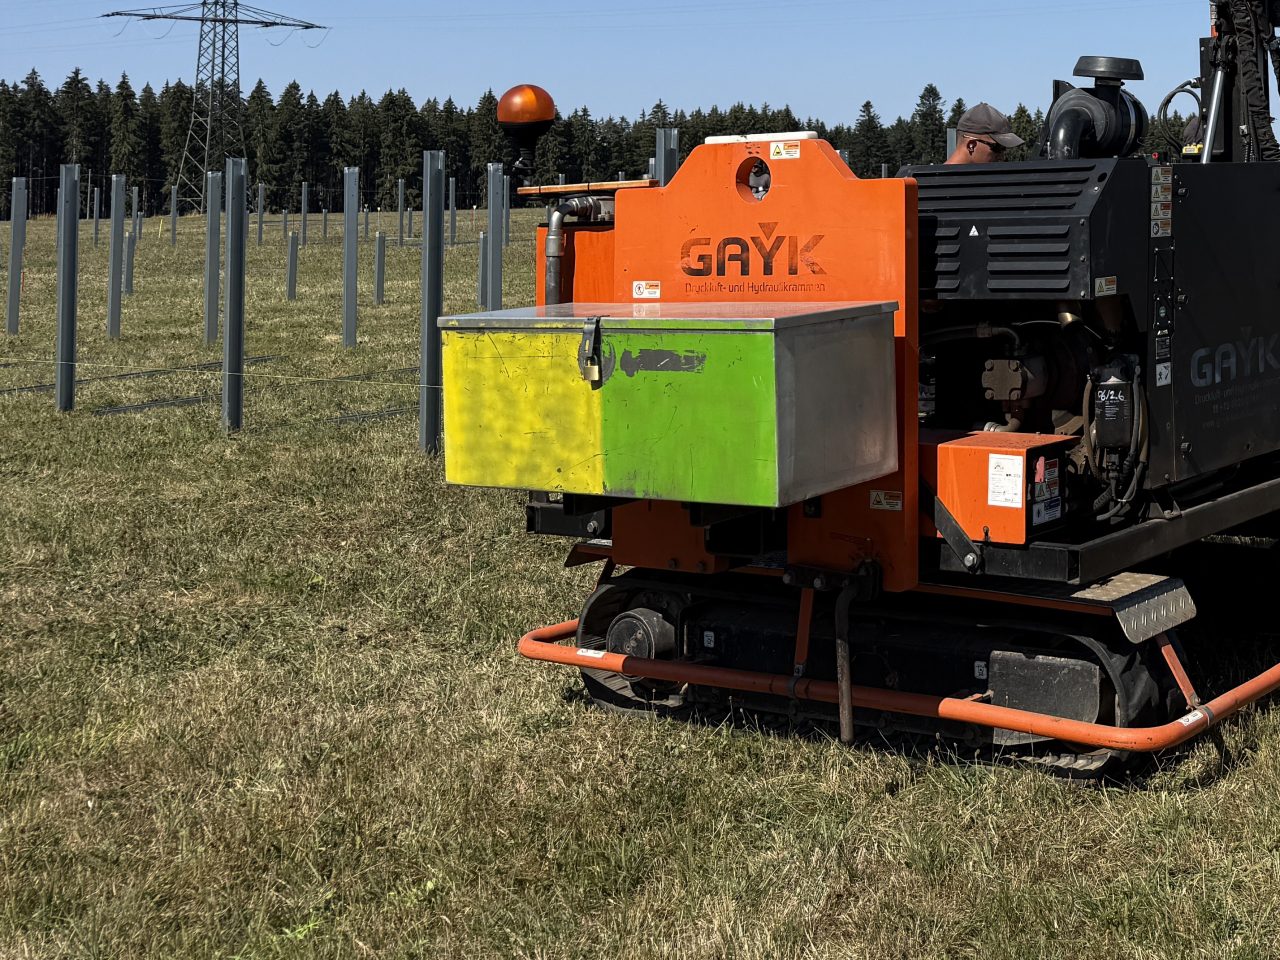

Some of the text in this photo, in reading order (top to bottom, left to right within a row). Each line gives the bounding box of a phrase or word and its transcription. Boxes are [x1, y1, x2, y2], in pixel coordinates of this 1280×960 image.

[680, 230, 828, 277] GAYK
[728, 281, 745, 292] und
[1190, 331, 1280, 388] GAYK
